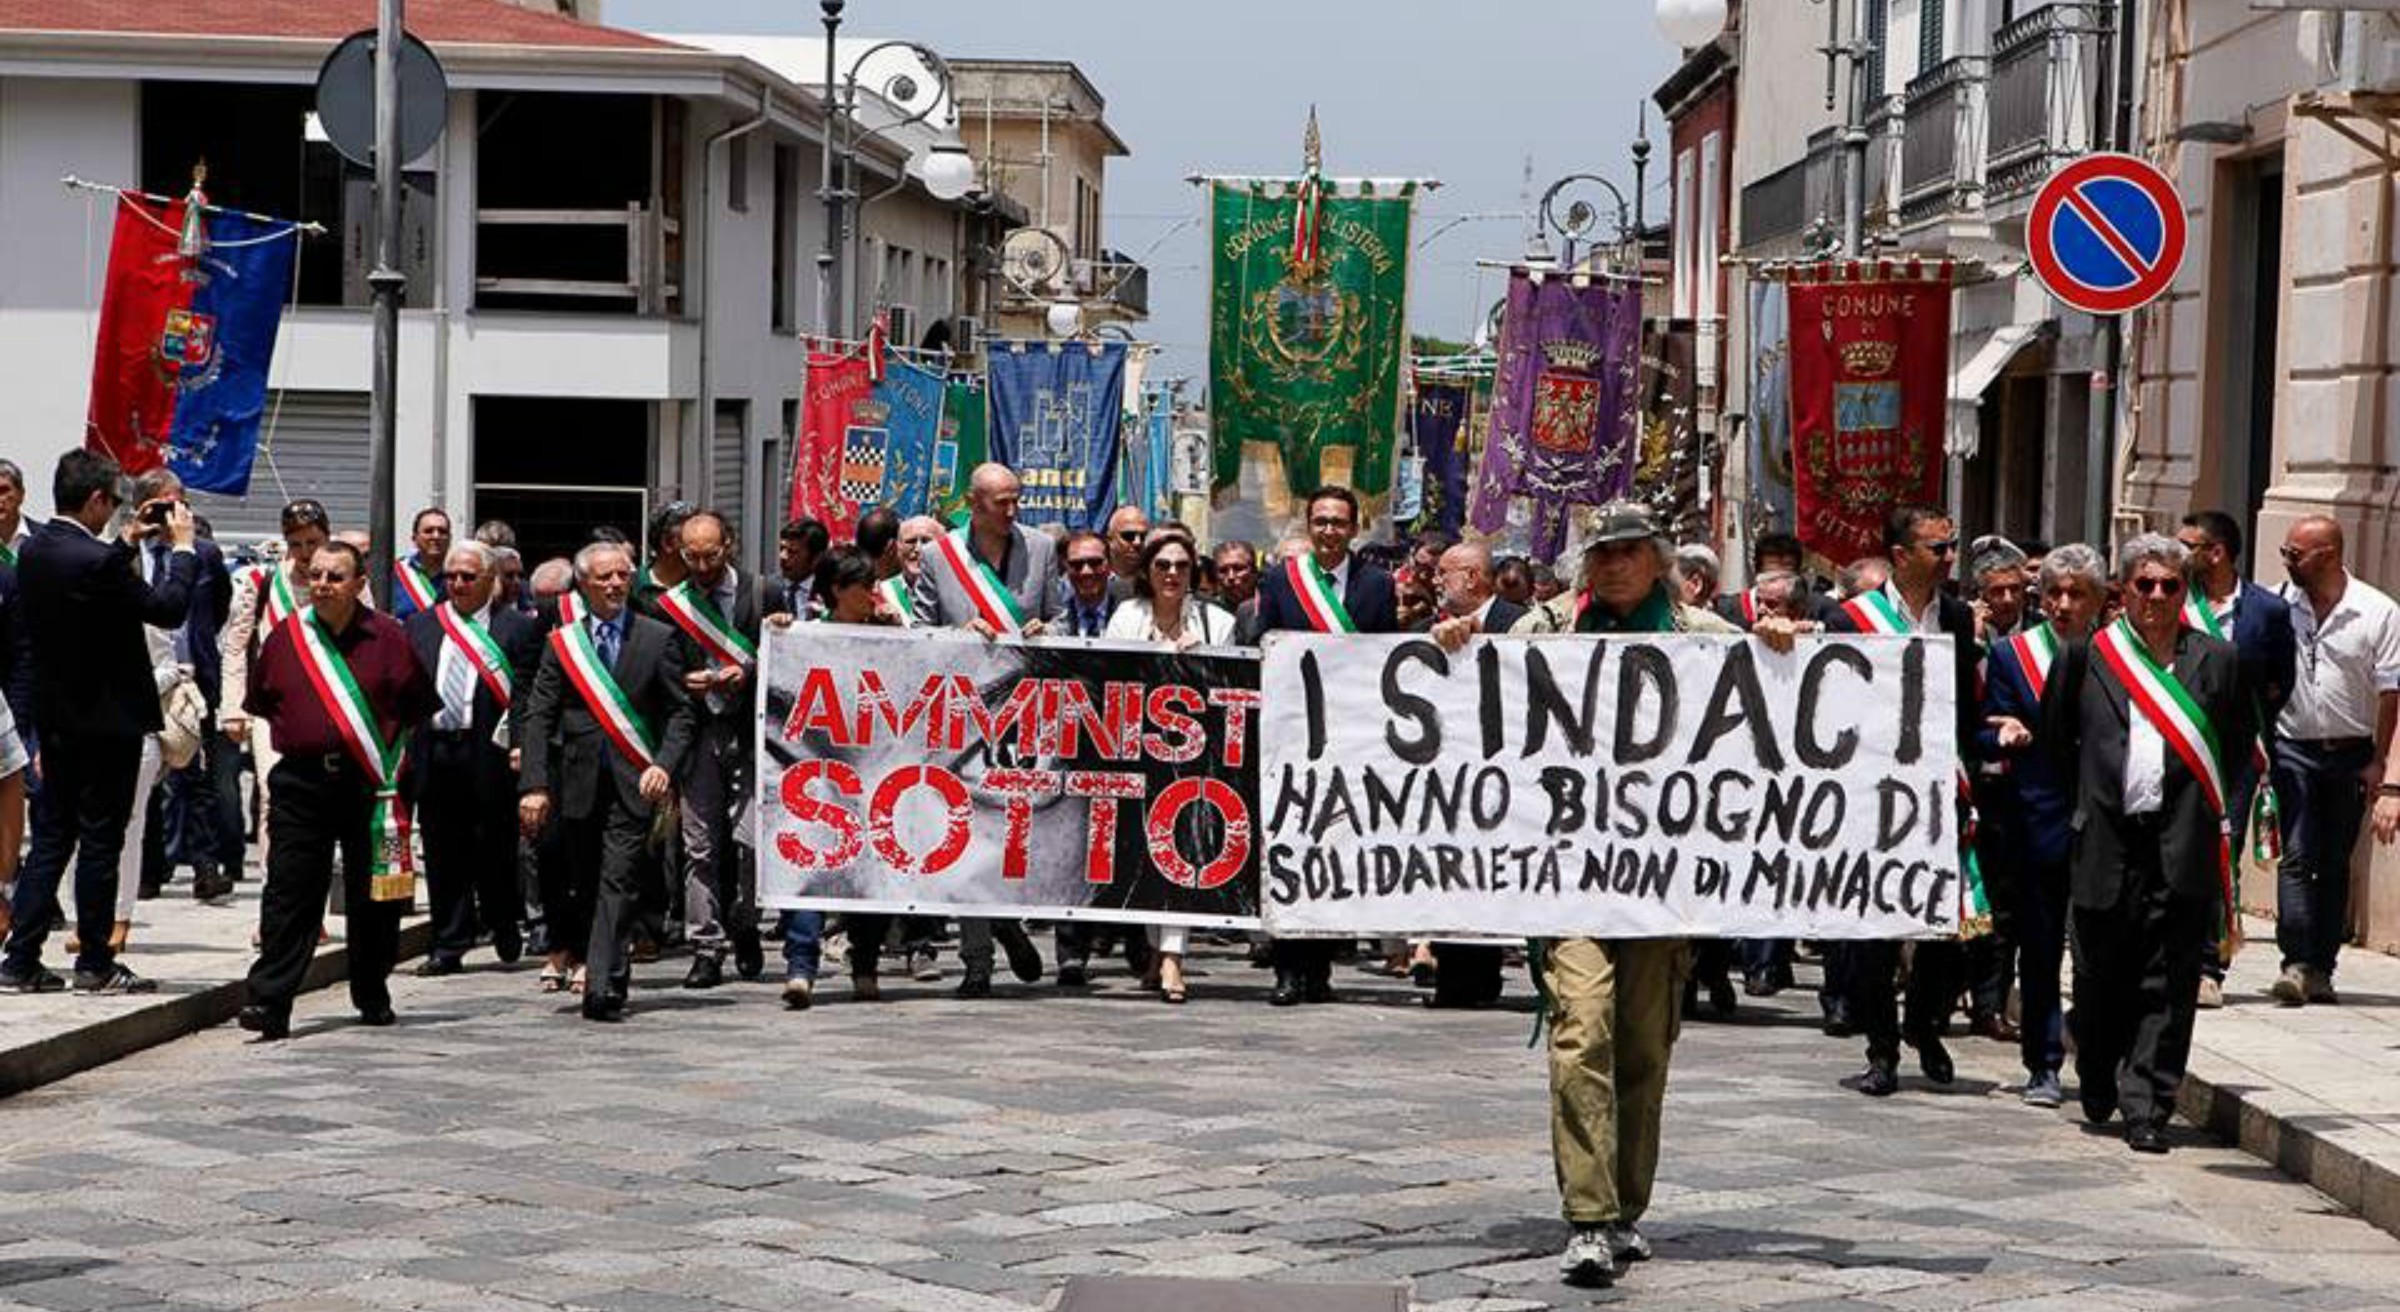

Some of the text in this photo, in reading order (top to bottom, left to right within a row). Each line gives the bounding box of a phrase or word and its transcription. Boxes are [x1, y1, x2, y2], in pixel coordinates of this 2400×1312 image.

[1822, 293, 1917, 317] COMUNE
[783, 667, 1262, 768] AMMINIST
[1299, 637, 1925, 774] I SINDACI
[776, 758, 1251, 889] SOTTO
[1268, 762, 1945, 852] HANNO BISOGNO DI
[1578, 842, 1679, 900] NON
[1694, 855, 1731, 901] DI
[1740, 847, 1956, 925] MINACCE
